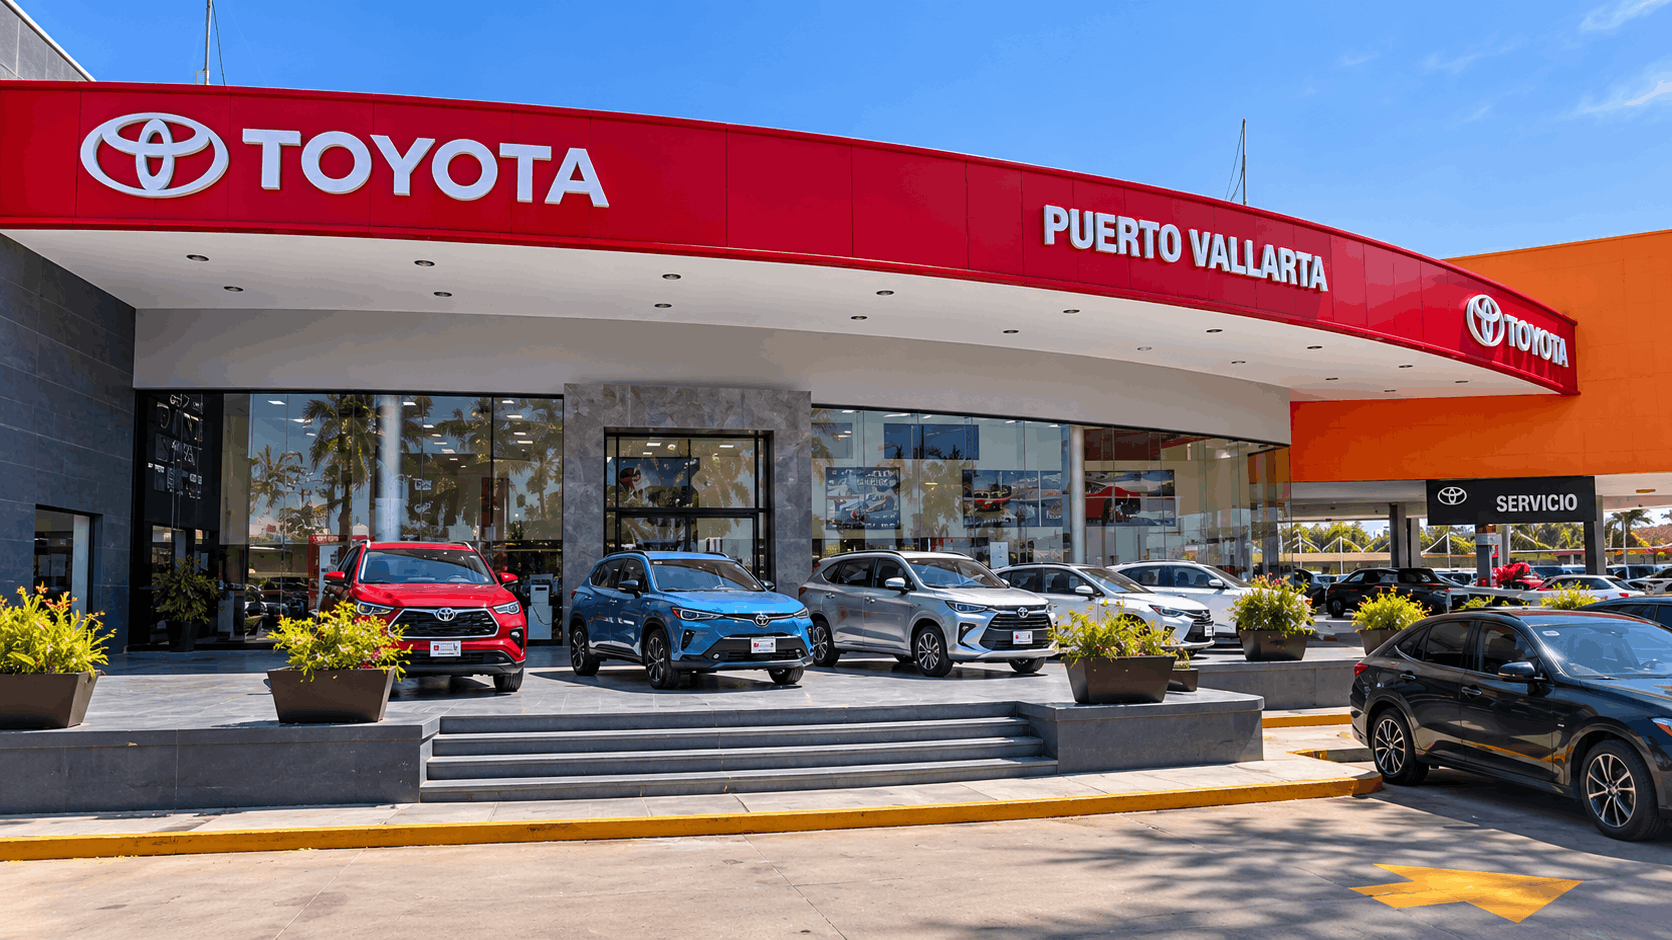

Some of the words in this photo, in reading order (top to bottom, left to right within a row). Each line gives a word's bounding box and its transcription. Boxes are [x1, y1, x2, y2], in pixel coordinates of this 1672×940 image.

[242, 128, 610, 209] TOYOTA
[1043, 204, 1183, 264] PUERTO
[1188, 228, 1329, 293] VALLARTA
[1504, 314, 1570, 369] TOYOTA
[1496, 493, 1578, 513] SERVICIO
